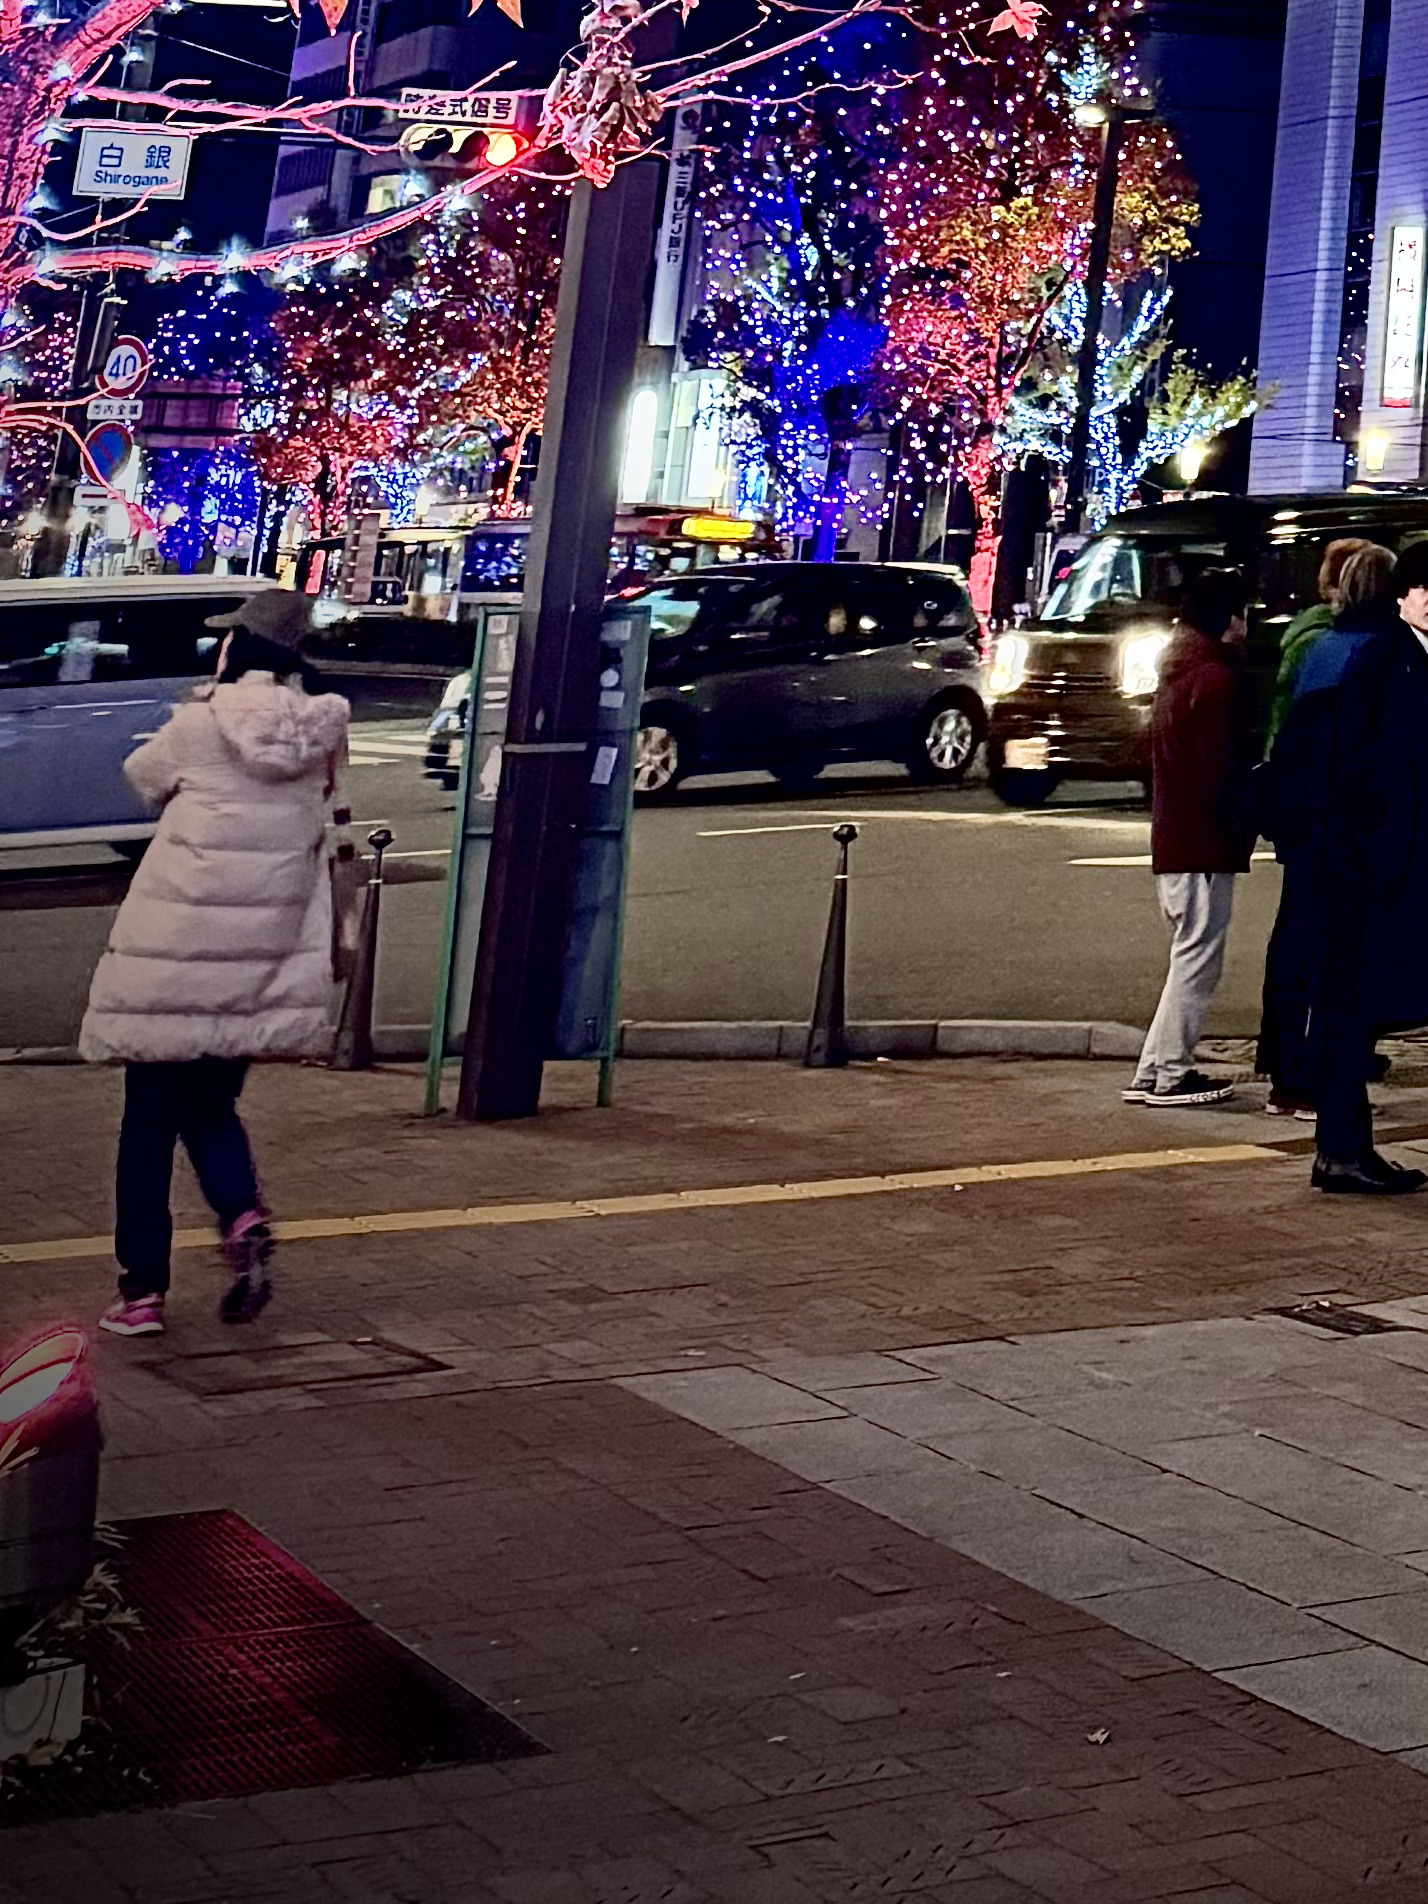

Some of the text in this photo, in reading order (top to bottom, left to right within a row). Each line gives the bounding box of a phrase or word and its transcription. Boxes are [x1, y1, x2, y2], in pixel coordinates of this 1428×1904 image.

[98, 142, 172, 170] 白銀
[93, 169, 169, 188] Shirogane
[108, 354, 138, 381] 40
